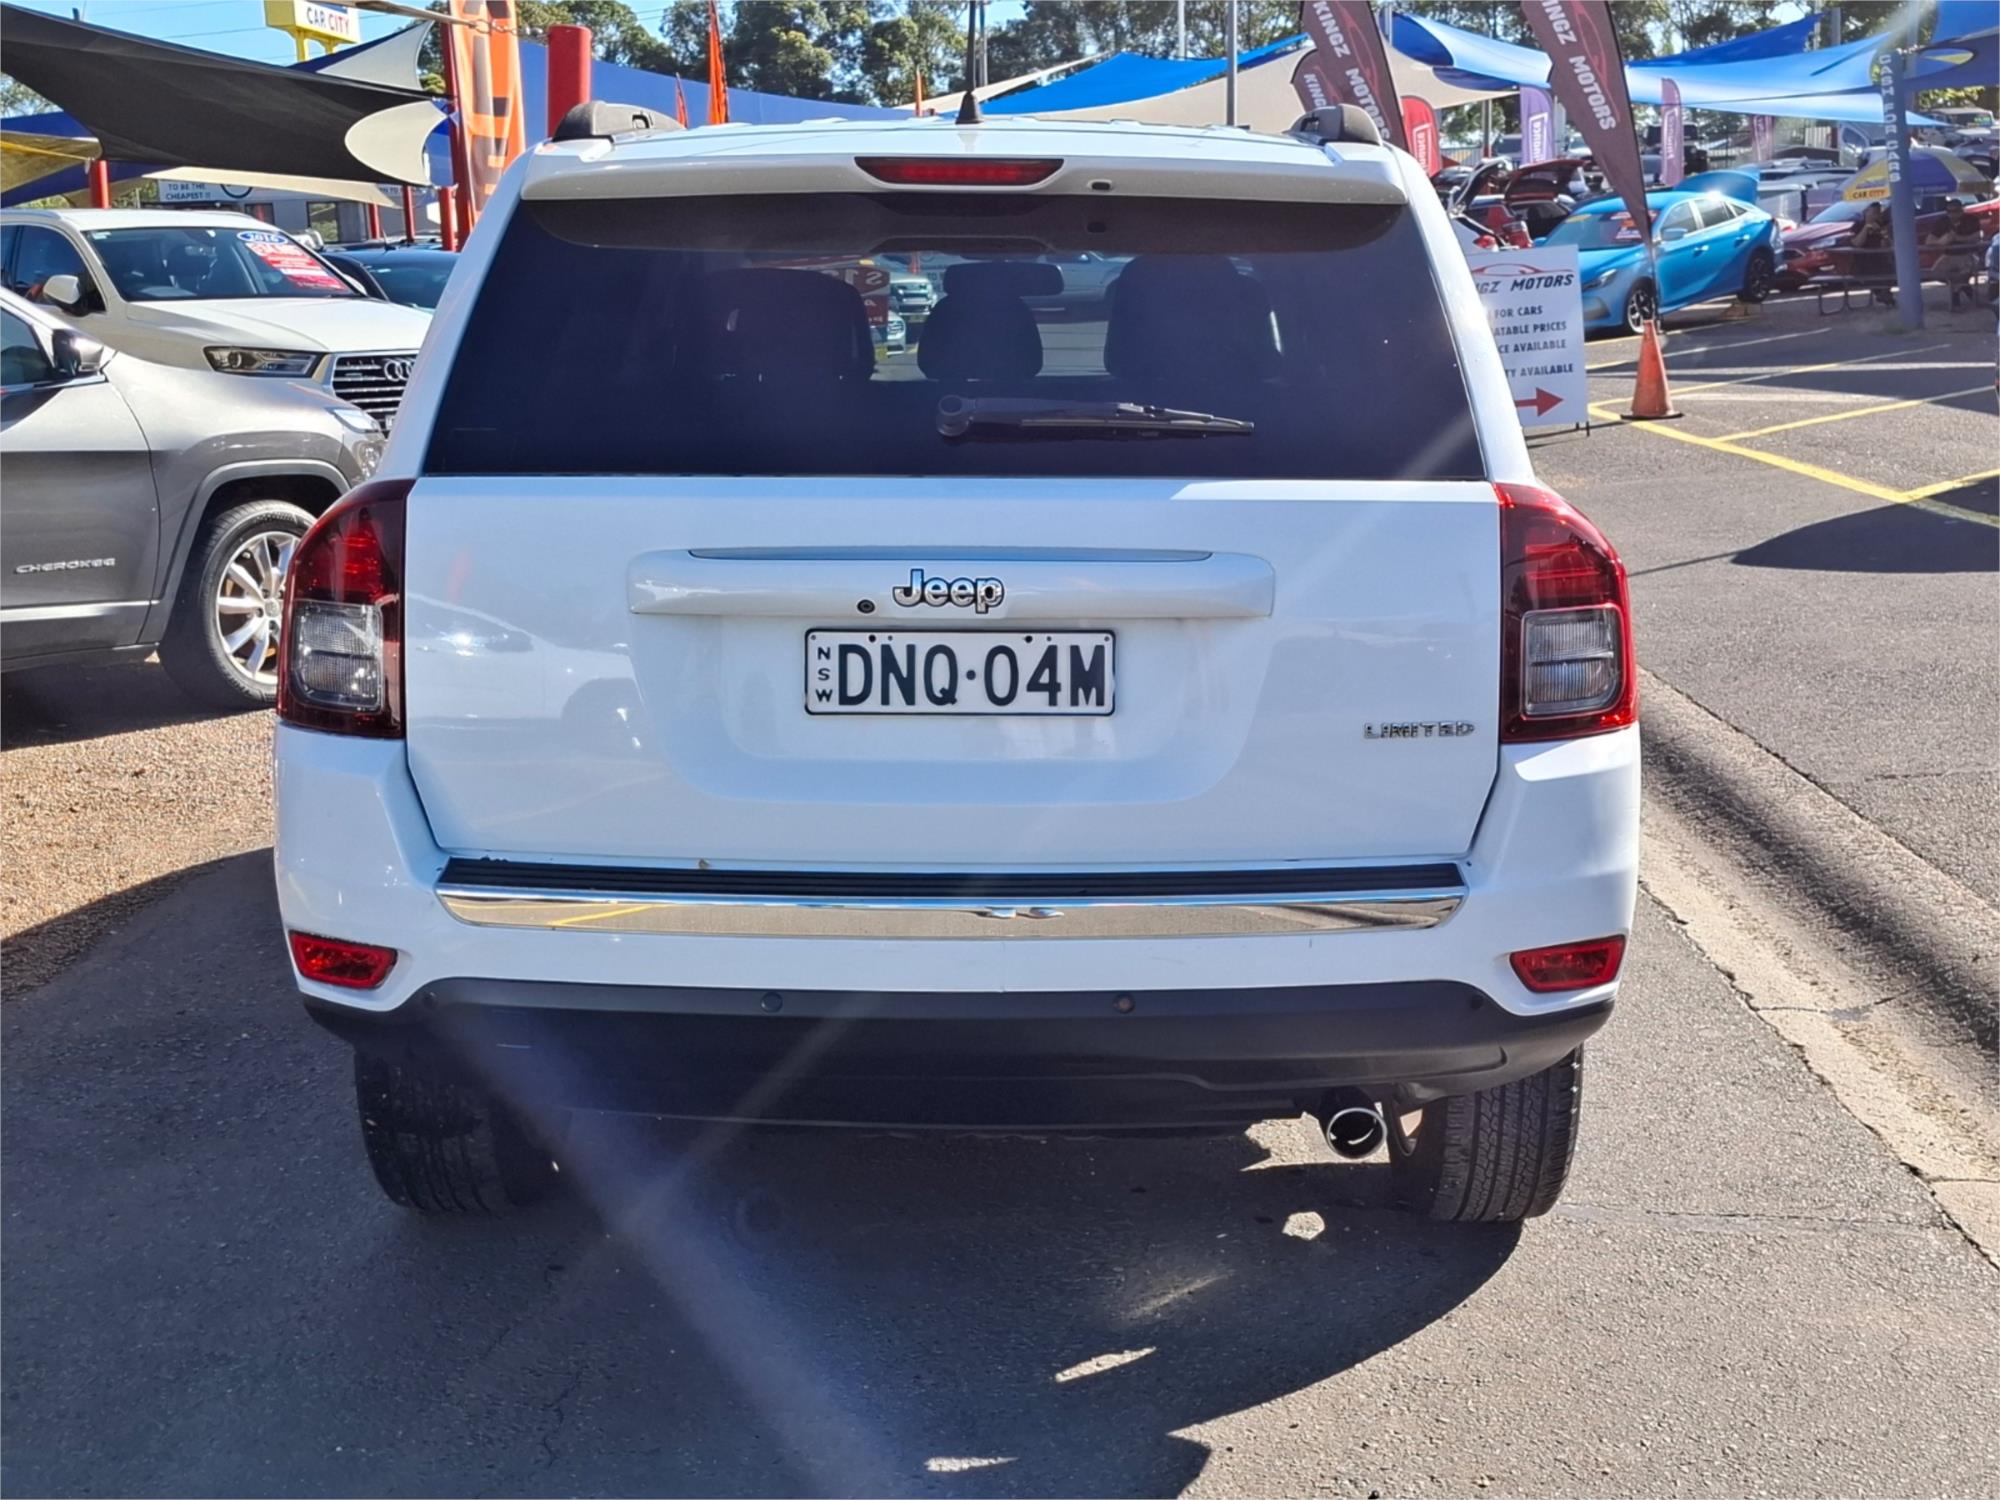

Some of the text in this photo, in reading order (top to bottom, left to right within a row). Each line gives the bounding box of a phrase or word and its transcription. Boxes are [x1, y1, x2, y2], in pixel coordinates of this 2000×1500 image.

[306, 6, 350, 35] CAR CITY
[1313, 1, 1351, 58] KINGZ
[1568, 55, 1617, 131] MOTORS
[1878, 53, 1902, 183] CASH FOR CARS
[168, 182, 207, 191] TO BE THE
[1852, 190, 1868, 200] CAR
[166, 191, 203, 200] CHEAPEST
[1510, 274, 1575, 292] MOTORS
[1494, 305, 1543, 318] FOR CARS
[1533, 321, 1567, 333] PRICES
[1513, 339, 1567, 353] AVAILABLE
[1520, 363, 1574, 377] AVAILABLE
[15, 557, 116, 574] CHEROKEE
[893, 568, 1005, 614] Jeep
[1364, 720, 1476, 740] LIMITED
